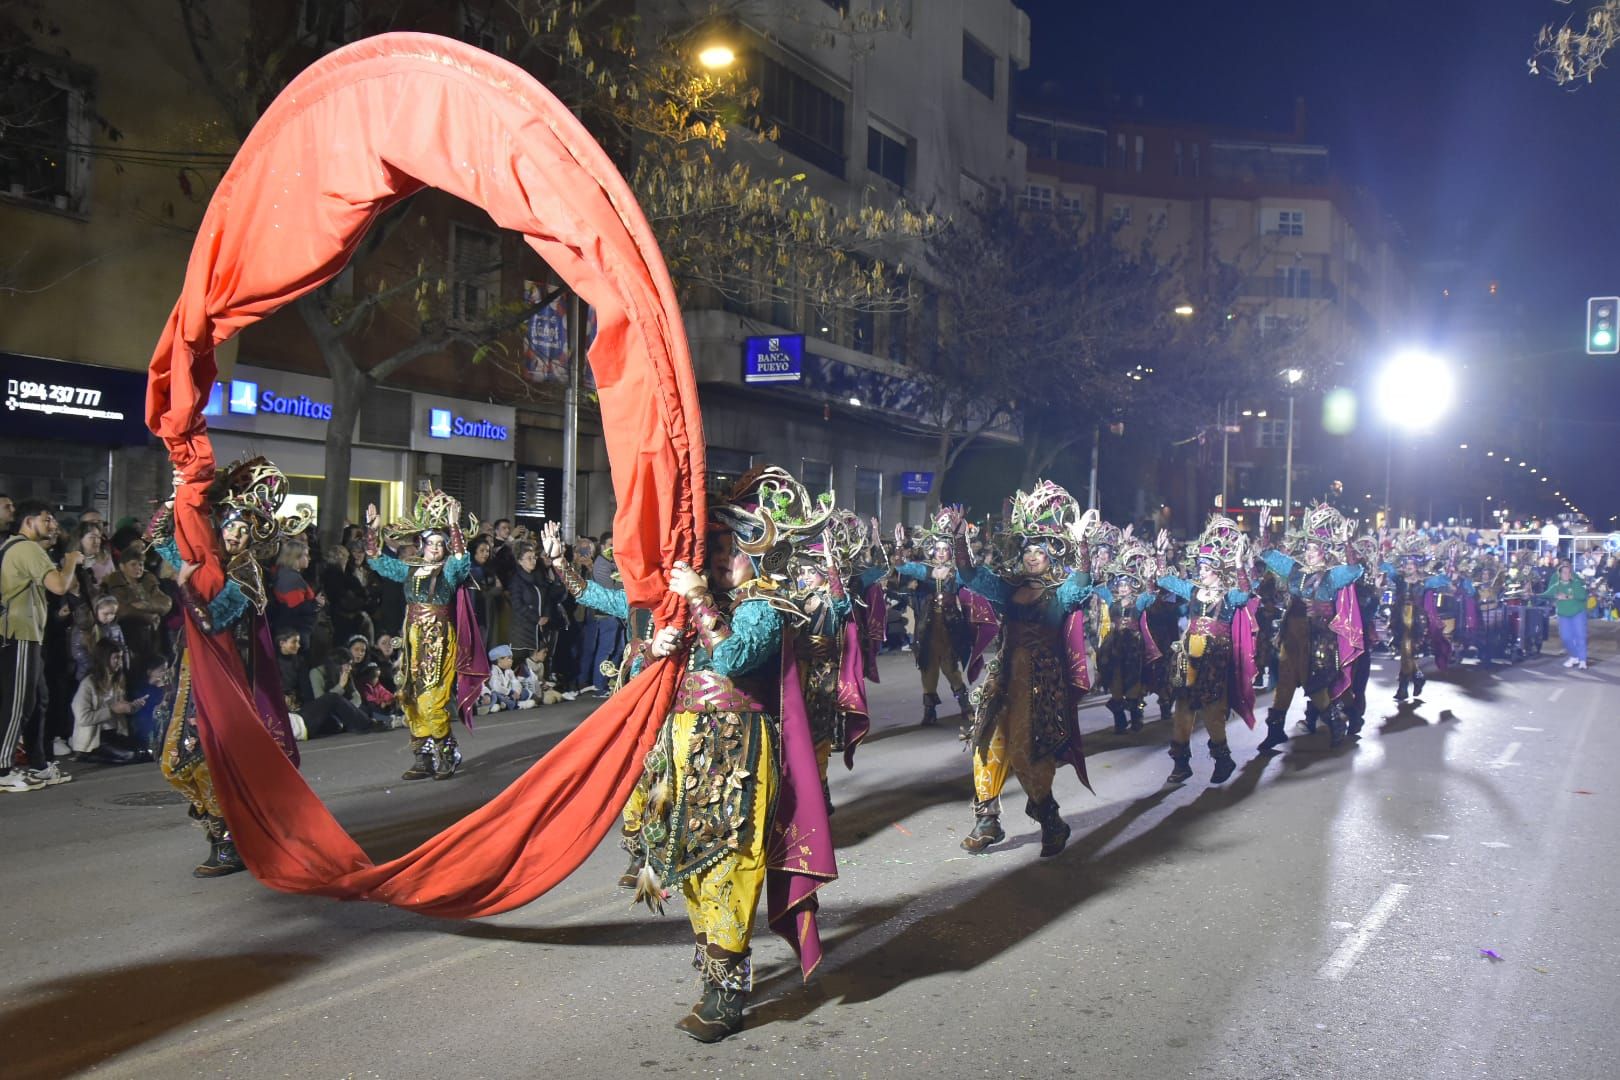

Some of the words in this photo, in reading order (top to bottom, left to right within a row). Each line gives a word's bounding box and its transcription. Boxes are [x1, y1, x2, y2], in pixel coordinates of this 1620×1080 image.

[757, 352, 790, 363] BANCA
[757, 362, 789, 372] PUEYO
[261, 390, 333, 420] Sanitas
[454, 416, 507, 441] Sanitas
